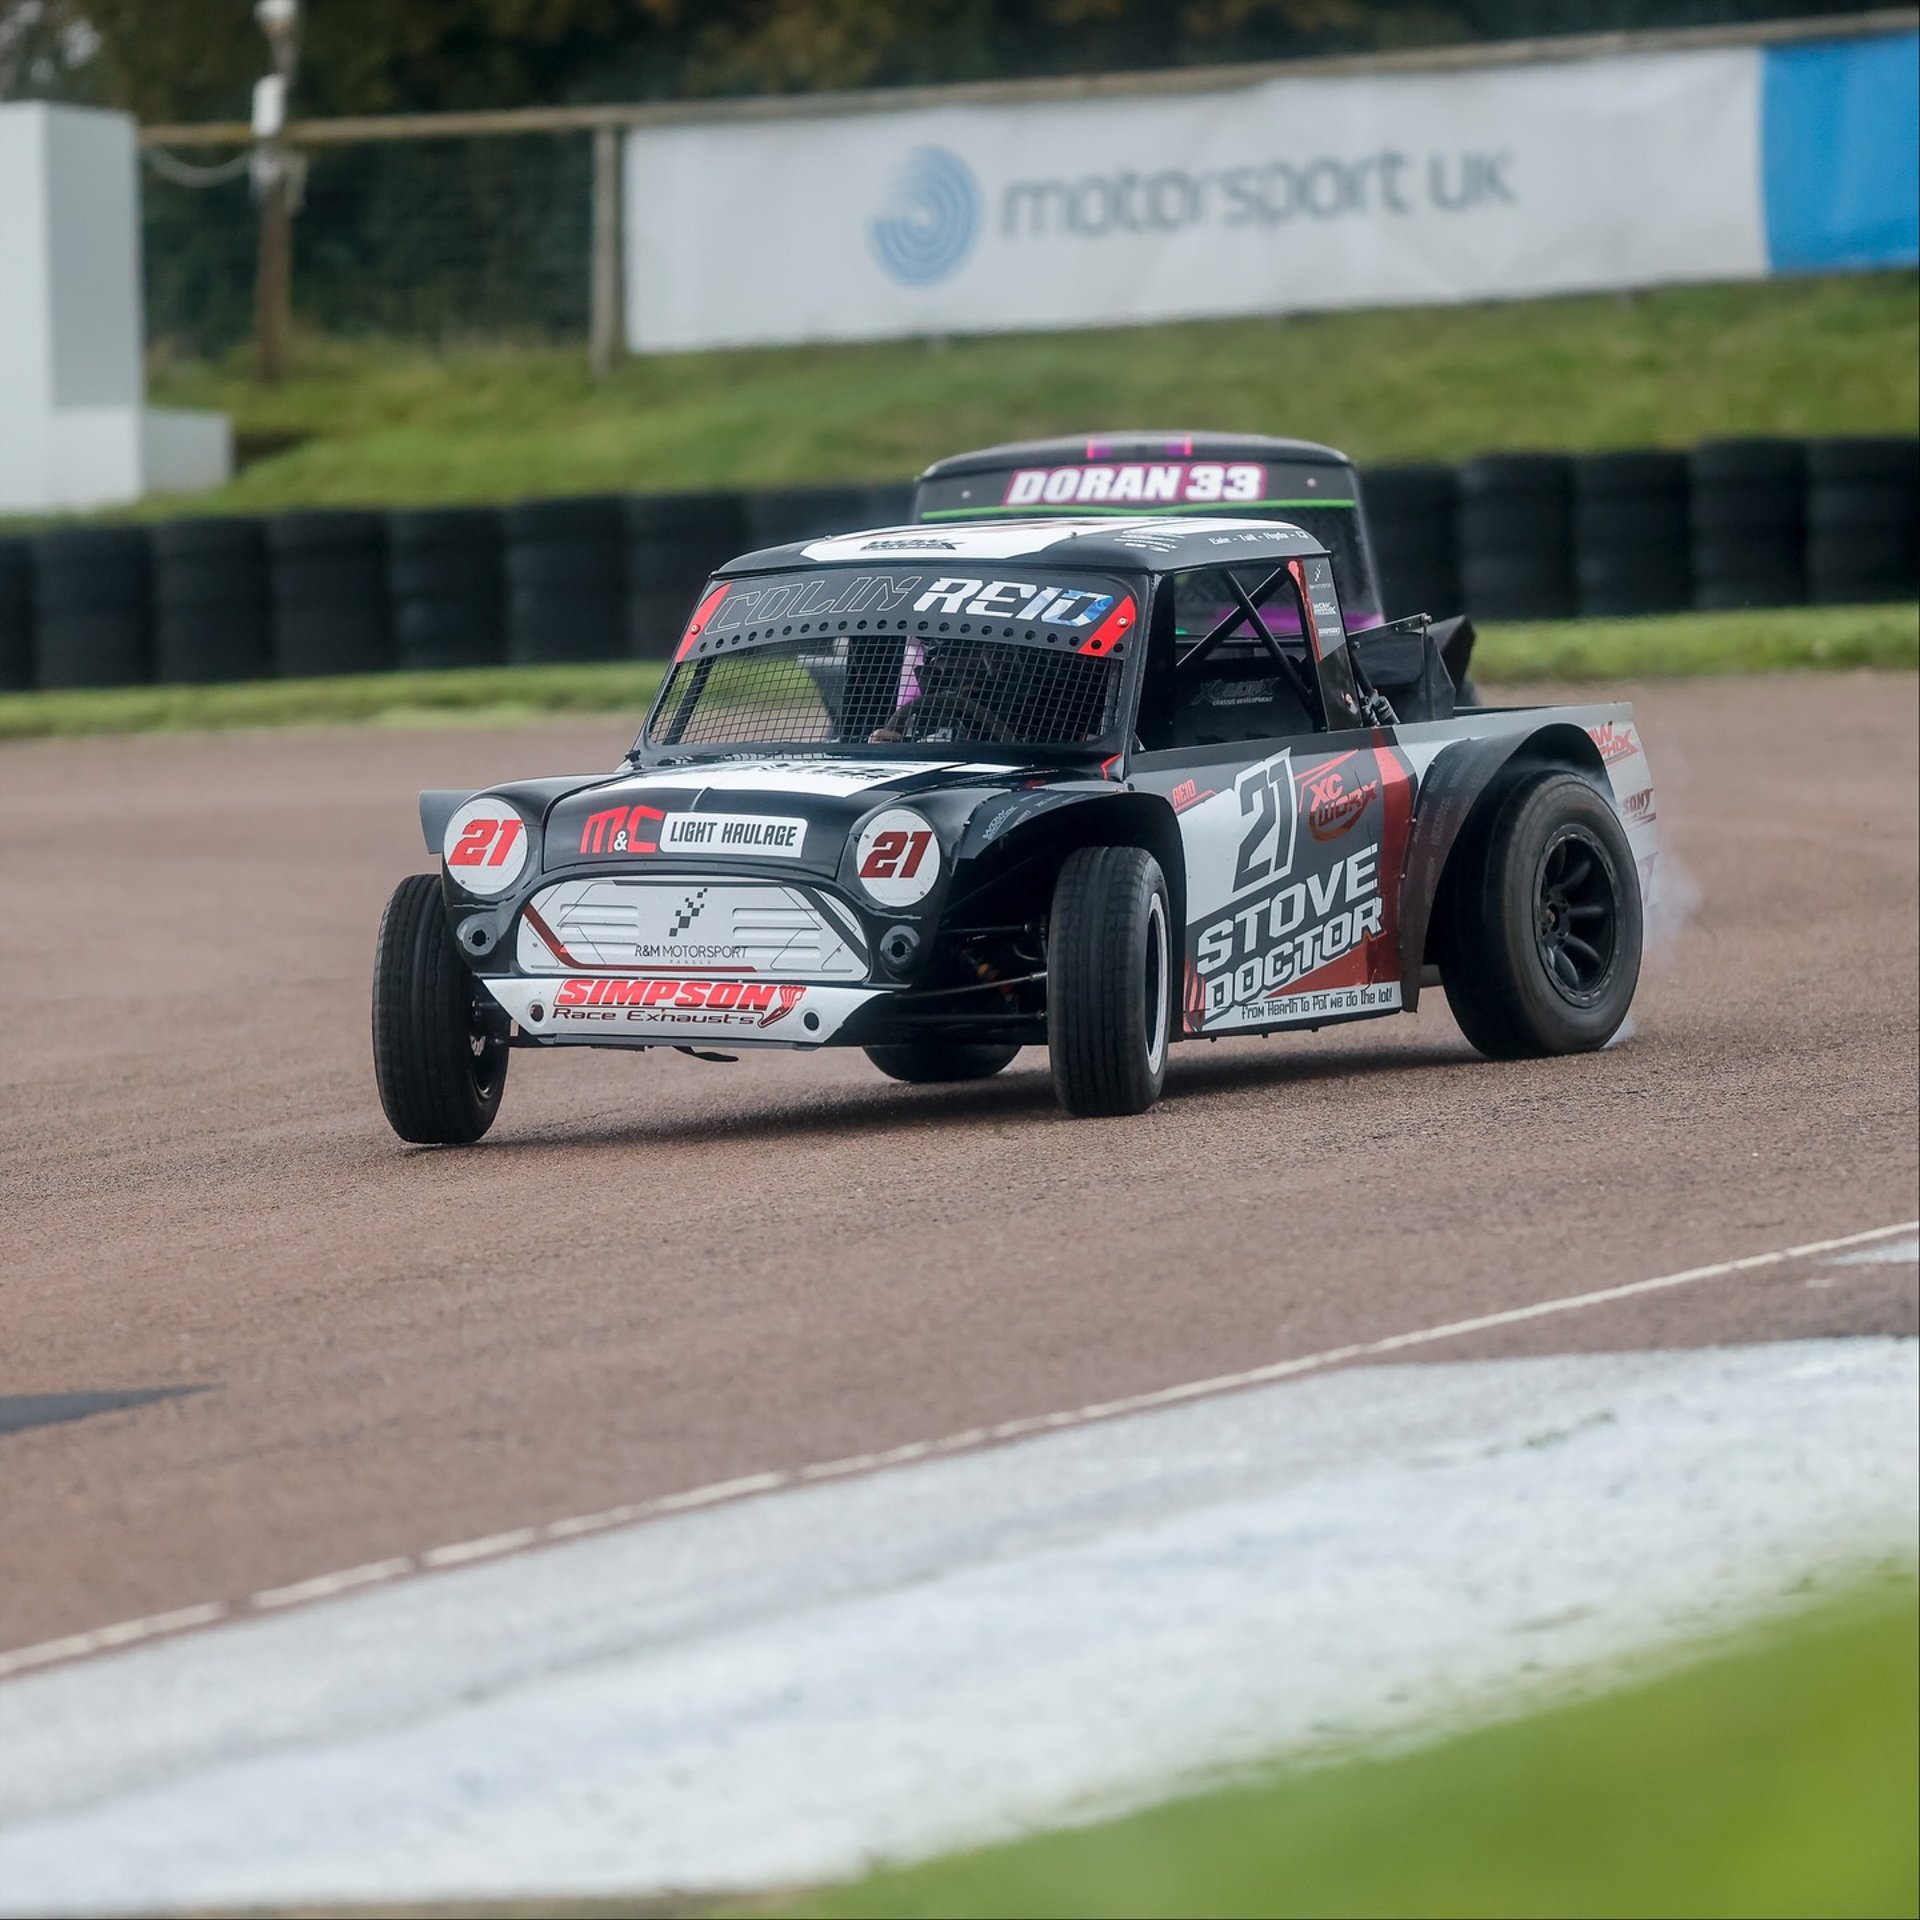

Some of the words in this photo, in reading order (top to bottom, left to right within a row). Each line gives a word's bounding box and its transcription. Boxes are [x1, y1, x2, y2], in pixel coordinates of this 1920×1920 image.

[1003, 149, 1406, 239] motorsport
[1006, 465, 1182, 505] DORAN
[1185, 465, 1262, 501] 33
[704, 576, 923, 635] COLIN
[912, 577, 1115, 628] REID
[1172, 779, 1197, 806] REID
[1310, 773, 1344, 813] XC
[447, 818, 524, 867] 21
[580, 805, 665, 854] M&C
[670, 821, 718, 843] LIGHT
[721, 822, 798, 847] HAULAGE
[1232, 749, 1295, 896] 21
[859, 830, 933, 878] 21
[1197, 842, 1378, 975] STOVE
[634, 945, 660, 957] R&M
[662, 944, 749, 958] MOTORSPORT
[1203, 896, 1383, 1020] DOCTOR
[552, 1007, 616, 1022] Race
[626, 1008, 754, 1025] Exhausts
[557, 979, 780, 1012] SIMPSON
